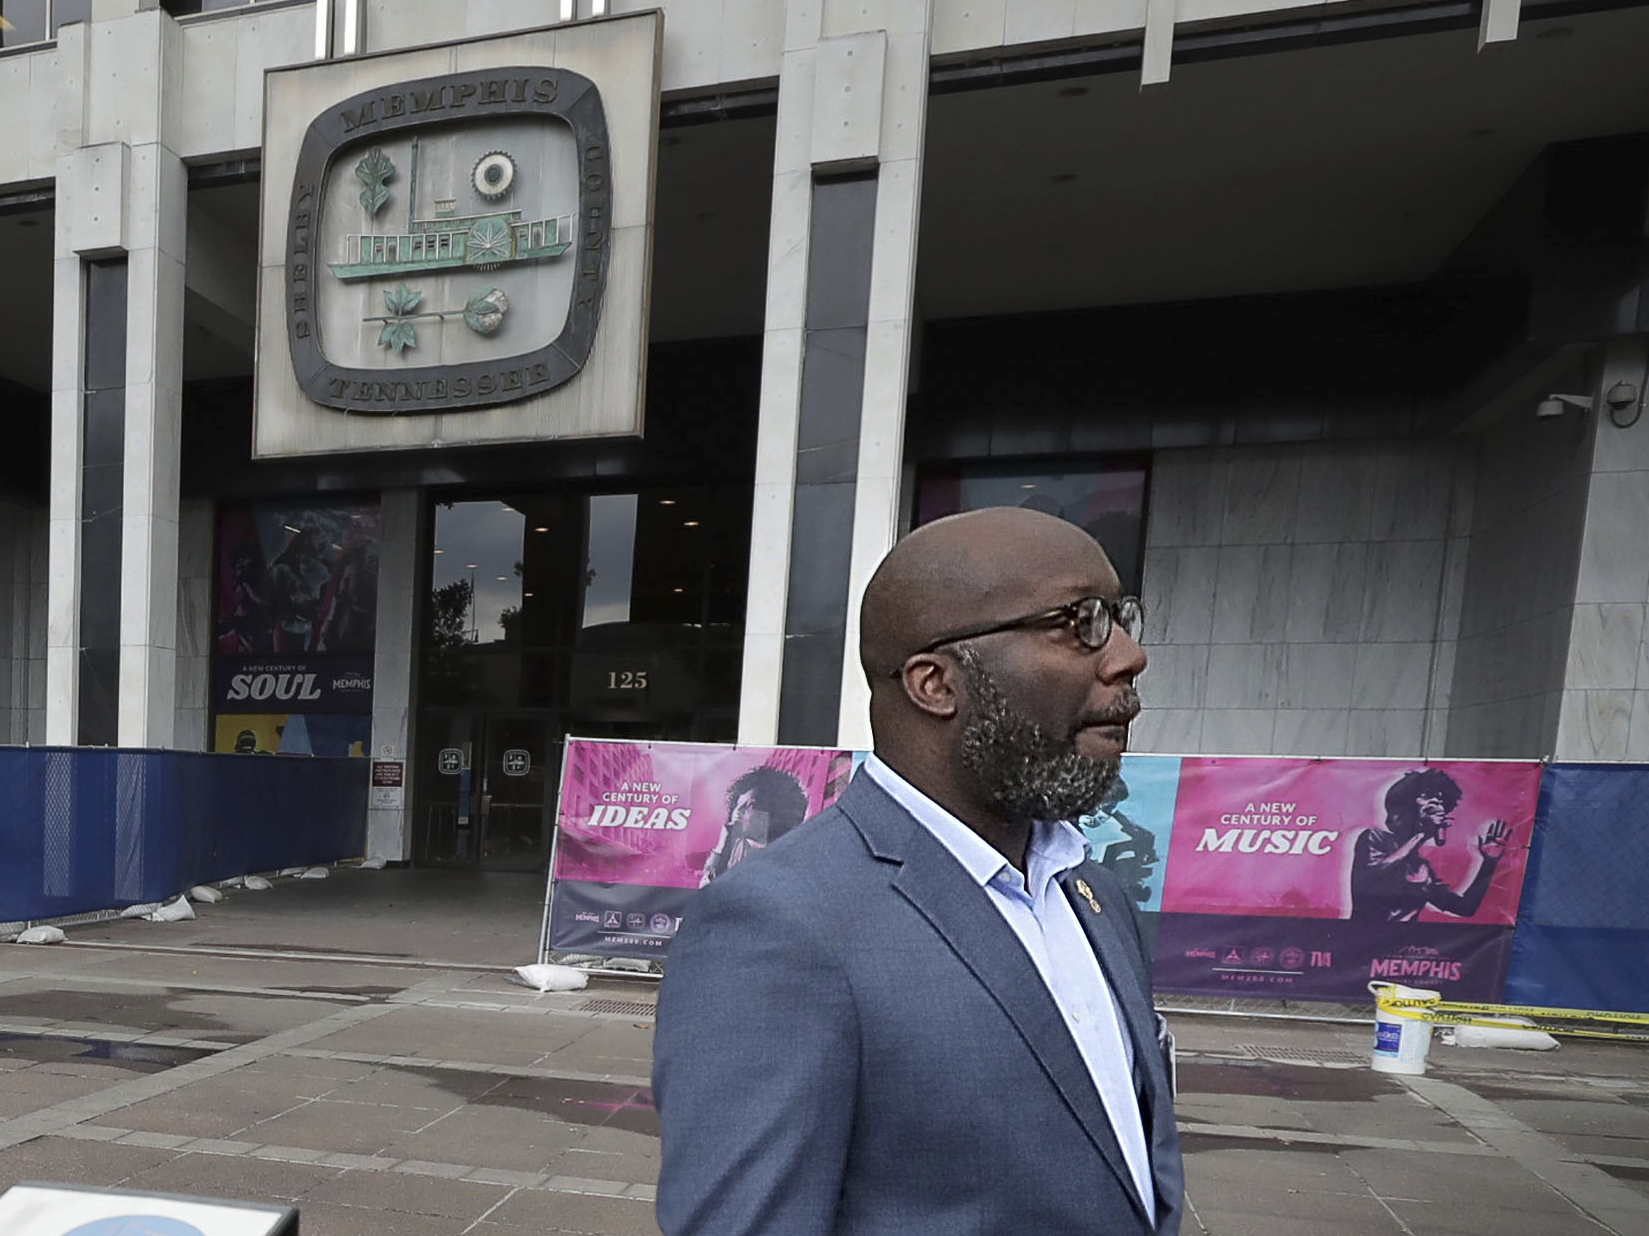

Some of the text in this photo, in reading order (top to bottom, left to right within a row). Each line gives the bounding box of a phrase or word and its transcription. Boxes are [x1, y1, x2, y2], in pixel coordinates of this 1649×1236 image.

[340, 78, 559, 133] MEMPHIS
[578, 141, 603, 309] COUNTY
[293, 183, 316, 339] SHELBY
[328, 362, 549, 402] TENNESSEE
[226, 674, 321, 700] SOUL
[332, 679, 371, 690] MEMPHIS
[607, 671, 648, 689] 125
[602, 792, 679, 804] CENTURY OF
[620, 782, 662, 792] A NEW
[588, 804, 692, 830] IDEAS
[1245, 802, 1296, 813] A NEW
[1220, 814, 1318, 826] CENTURY OF
[1195, 828, 1339, 854] MUSIC
[1370, 958, 1462, 980] MEMPHIS
